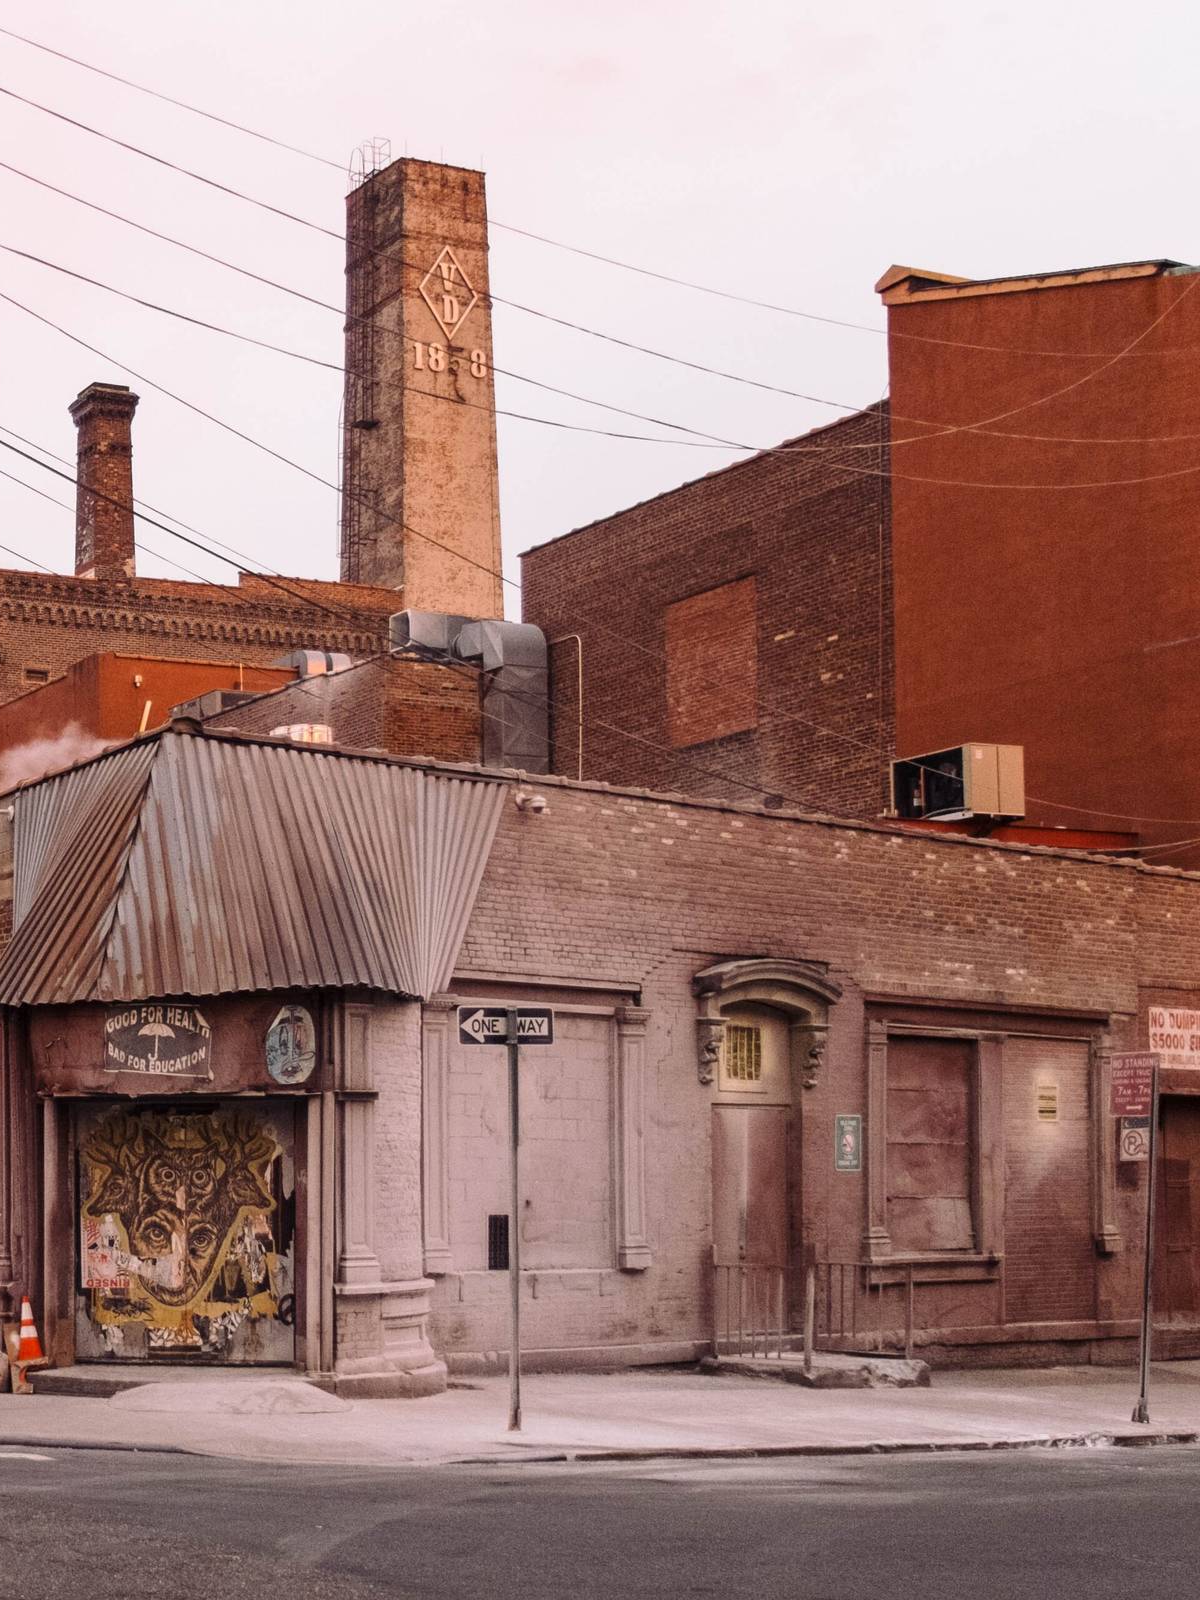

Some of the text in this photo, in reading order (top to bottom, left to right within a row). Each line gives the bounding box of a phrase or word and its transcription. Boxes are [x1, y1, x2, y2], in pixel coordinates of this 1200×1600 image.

[439, 262, 457, 291] V
[441, 295, 460, 324] D
[106, 1009, 138, 1033] GOOD
[141, 1006, 164, 1024] FOR
[471, 1018, 545, 1034] ONE WAY
[1150, 1011, 1165, 1029] NO
[107, 1041, 207, 1072] BAD FOR EDUCATION
[86, 1279, 130, 1288] RINSED
